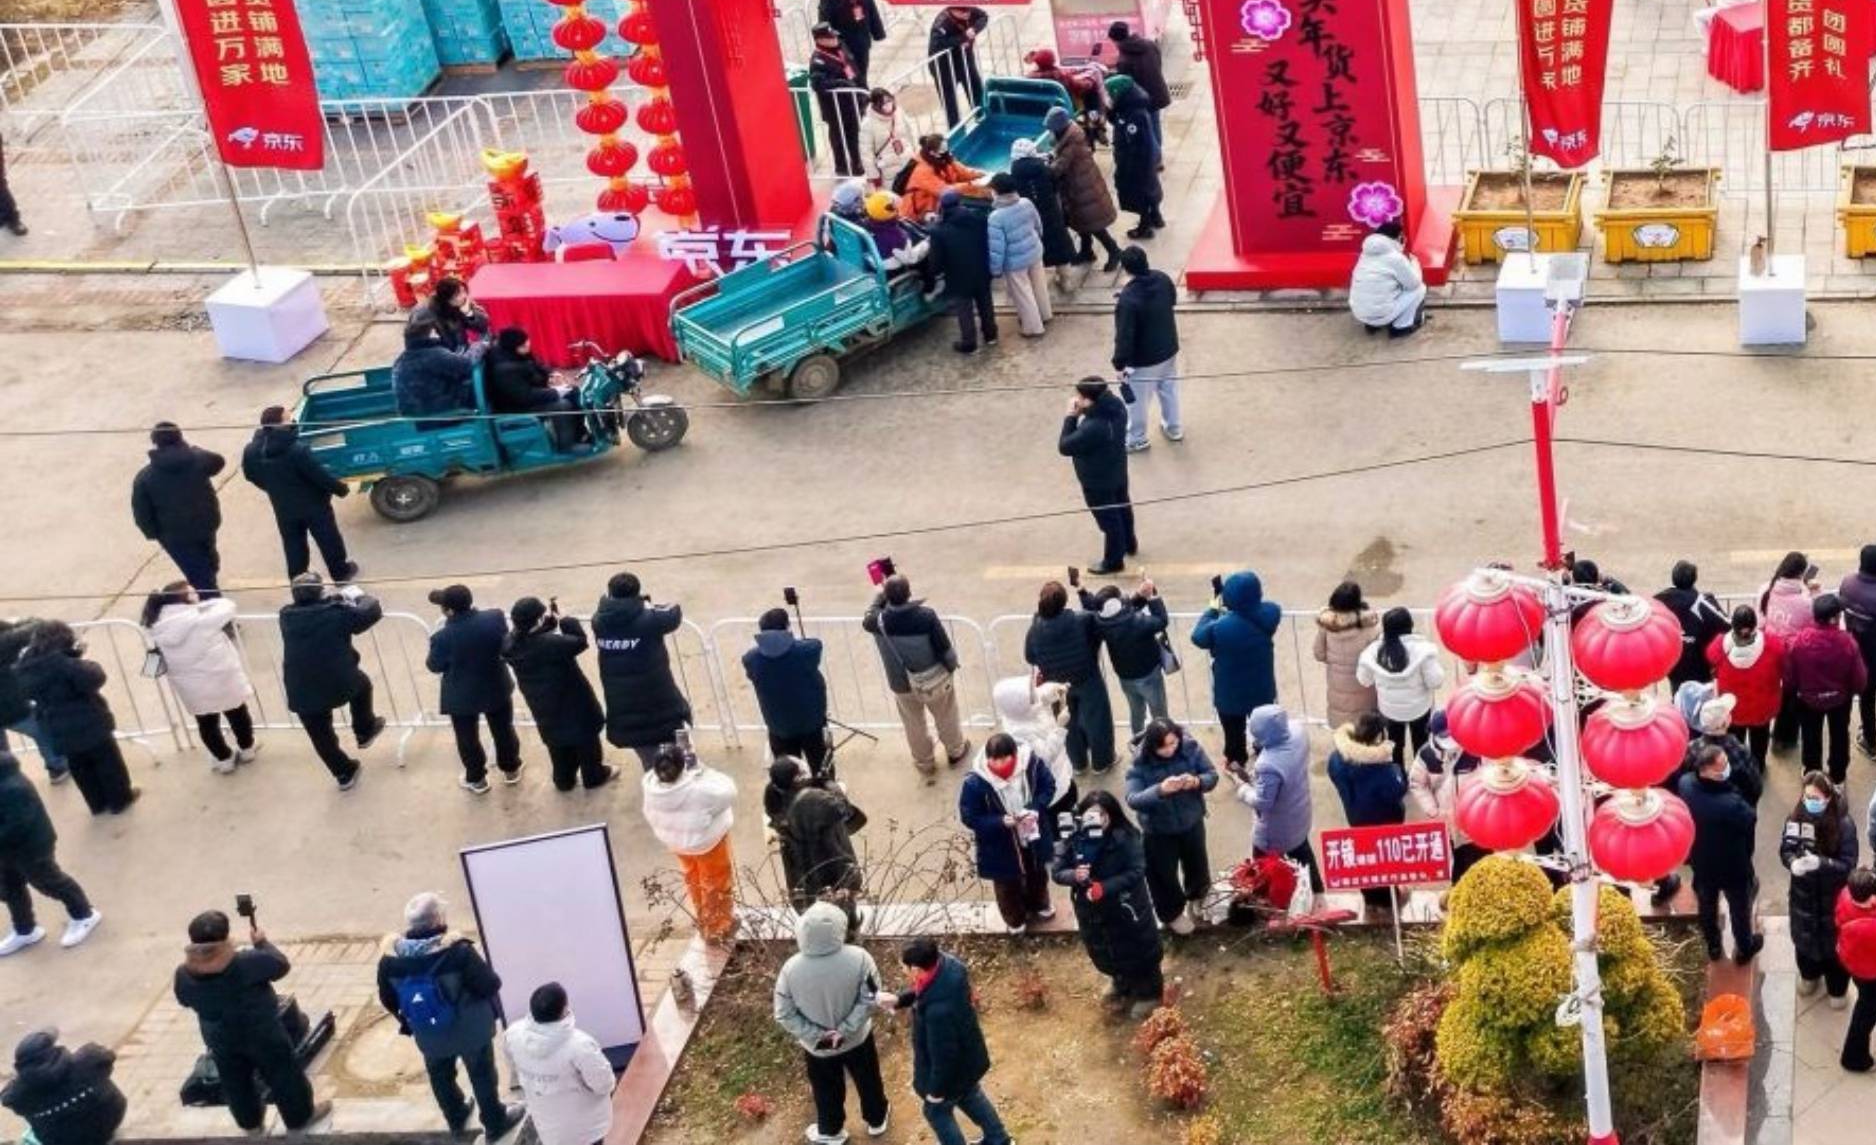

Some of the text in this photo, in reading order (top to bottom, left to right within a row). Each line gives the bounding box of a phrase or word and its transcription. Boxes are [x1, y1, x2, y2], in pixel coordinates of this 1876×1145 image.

[1817, 111, 1854, 129] 京东
[263, 131, 304, 152] 京东
[1259, 59, 1318, 220] 又好又便宜
[655, 225, 792, 277] 京东
